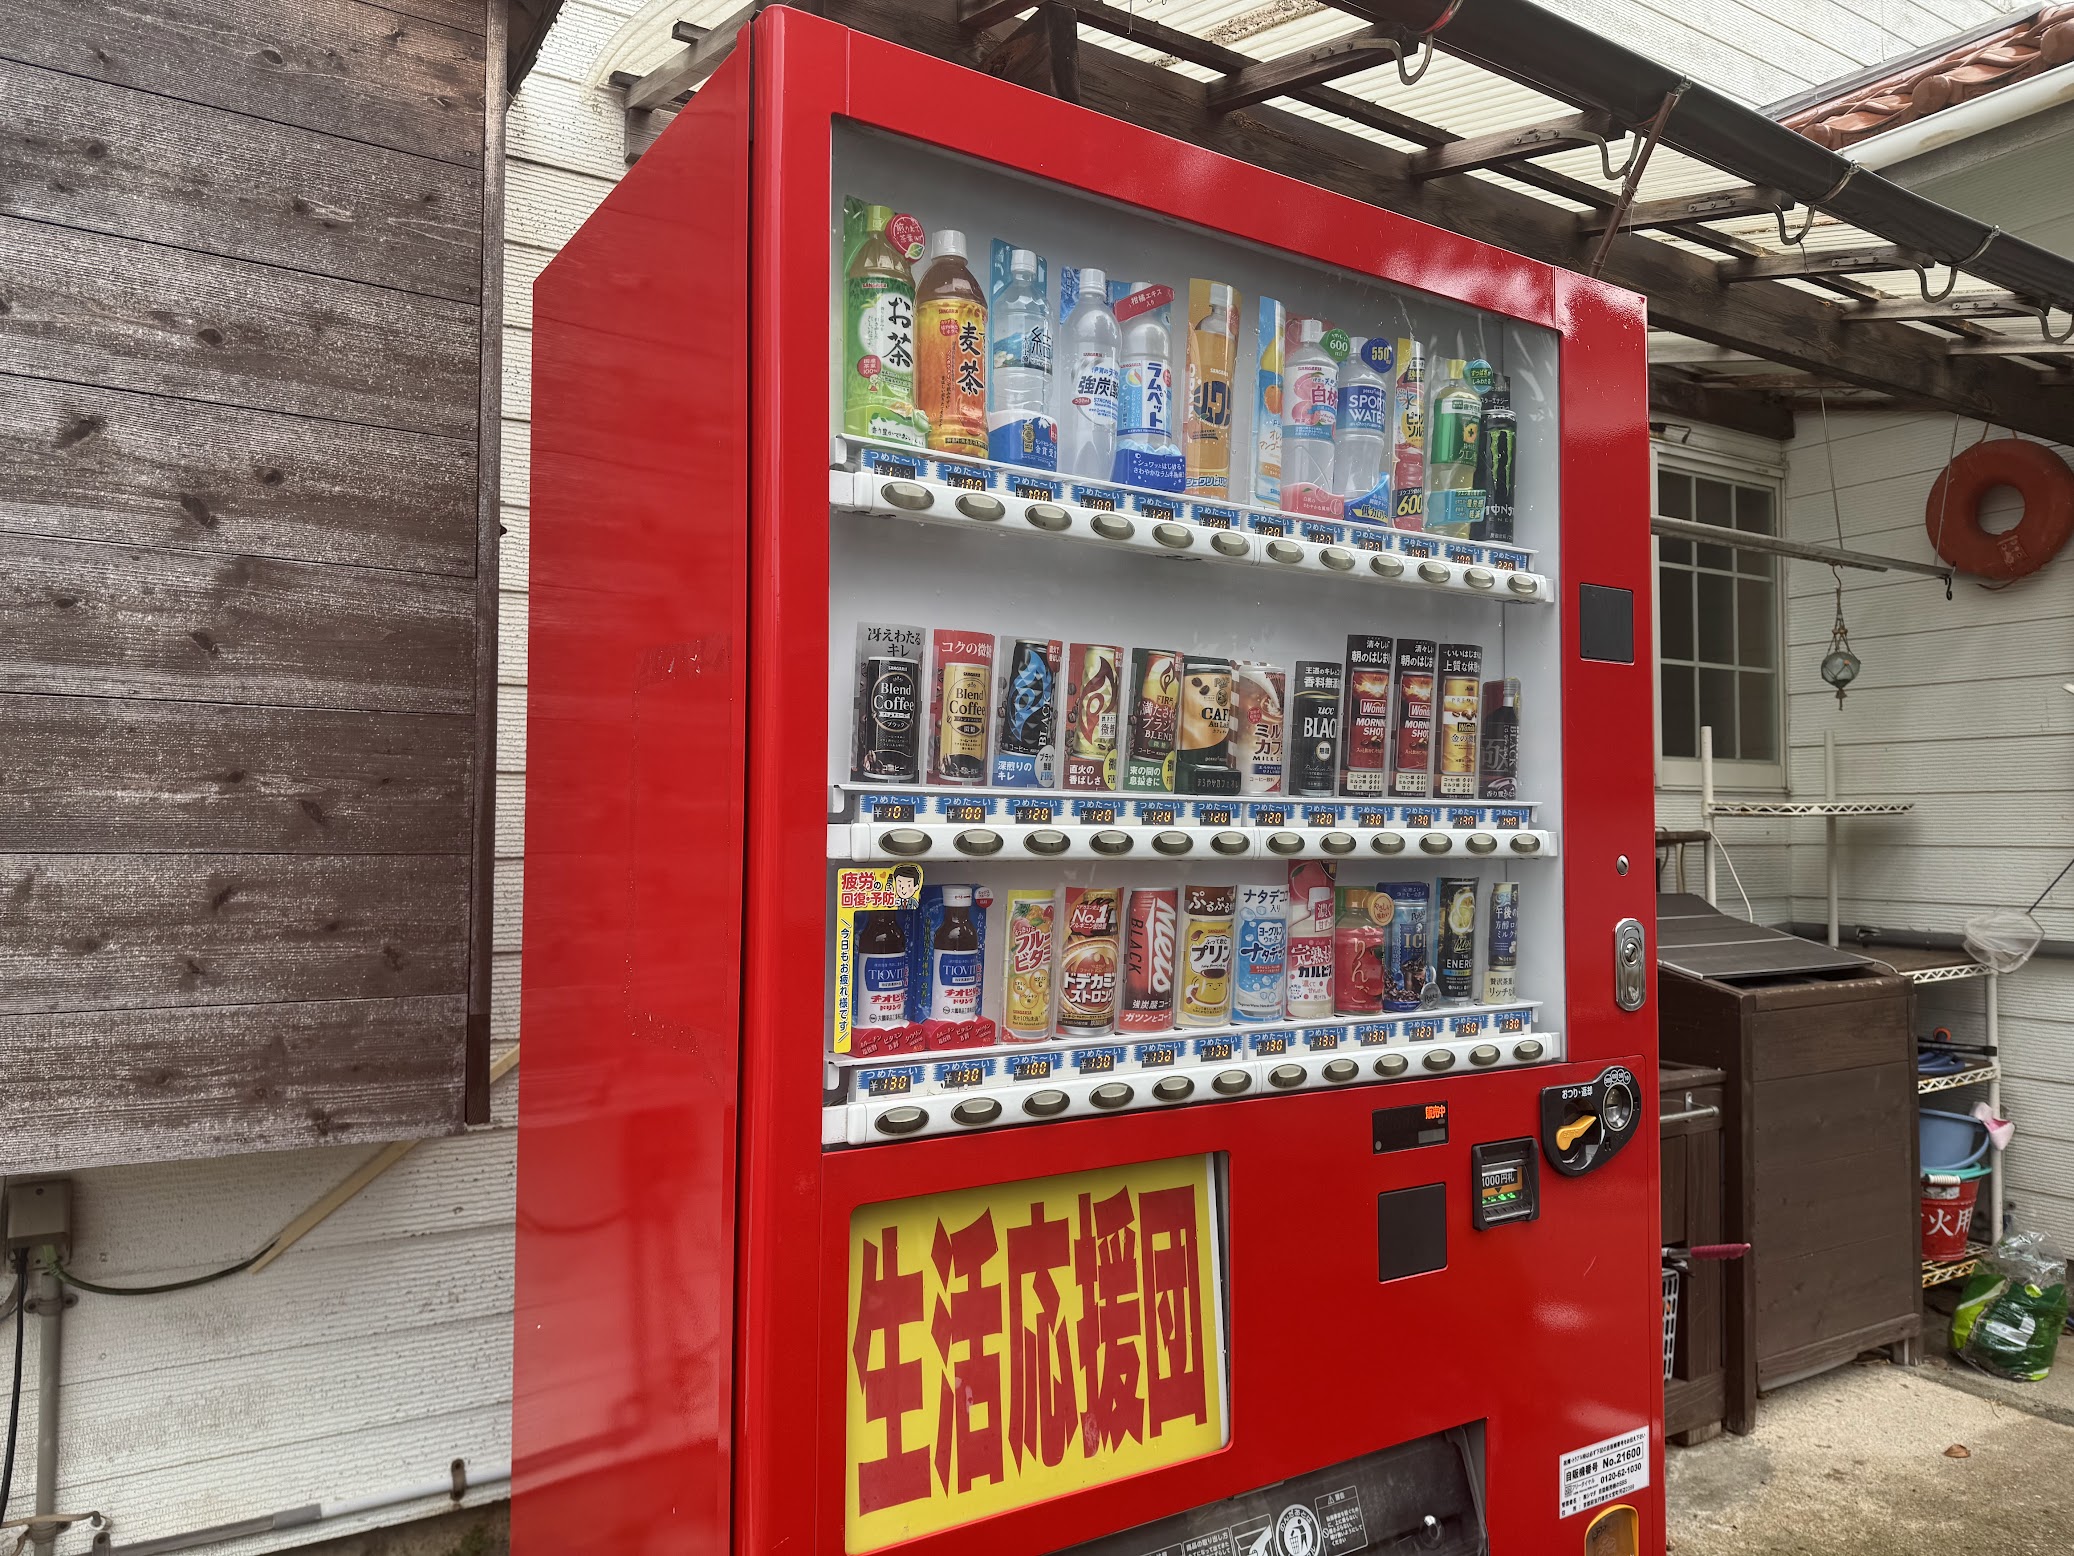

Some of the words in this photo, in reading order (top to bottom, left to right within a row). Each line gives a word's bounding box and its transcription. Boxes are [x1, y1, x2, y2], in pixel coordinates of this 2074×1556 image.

[882, 297, 914, 369] お茶
[1329, 339, 1348, 352] 600
[1371, 346, 1390, 361] 550
[957, 321, 985, 396] 麦茶
[867, 627, 921, 646] 冴えわたる
[887, 643, 911, 657] キレ
[881, 682, 912, 696] Blend
[955, 687, 984, 700] Blend
[873, 694, 915, 711] Coffee
[949, 700, 986, 716] Coffee
[997, 760, 1032, 771] 深煎りの
[1069, 764, 1095, 774] 直火の
[1129, 765, 1161, 776] 束の間の
[997, 772, 1015, 781] キレ
[1068, 775, 1101, 785] 香ばしさ
[1128, 776, 1161, 787] 息抜きに
[841, 871, 882, 891] 疲労の
[841, 891, 902, 908] 回復・予防に
[1072, 904, 1109, 924] No.1
[1269, 904, 1281, 913] 入り
[1128, 917, 1144, 975] BLACK
[1404, 933, 1426, 949] IC
[839, 928, 850, 1033] 今日もお疲れ様です
[1132, 998, 1172, 1010] 強炭酸コー
[1123, 1011, 1172, 1023] ガツンとコー
[1425, 1104, 1446, 1120] 販売中
[1481, 1172, 1515, 1188] 1000円札
[1921, 1206, 1974, 1237] 火用
[851, 1183, 1208, 1517] 生活応援団
[1565, 1462, 1599, 1482] 自販機番号
[1602, 1446, 1641, 1469] No.21600
[1600, 1462, 1642, 1484] 0120-62-1030
